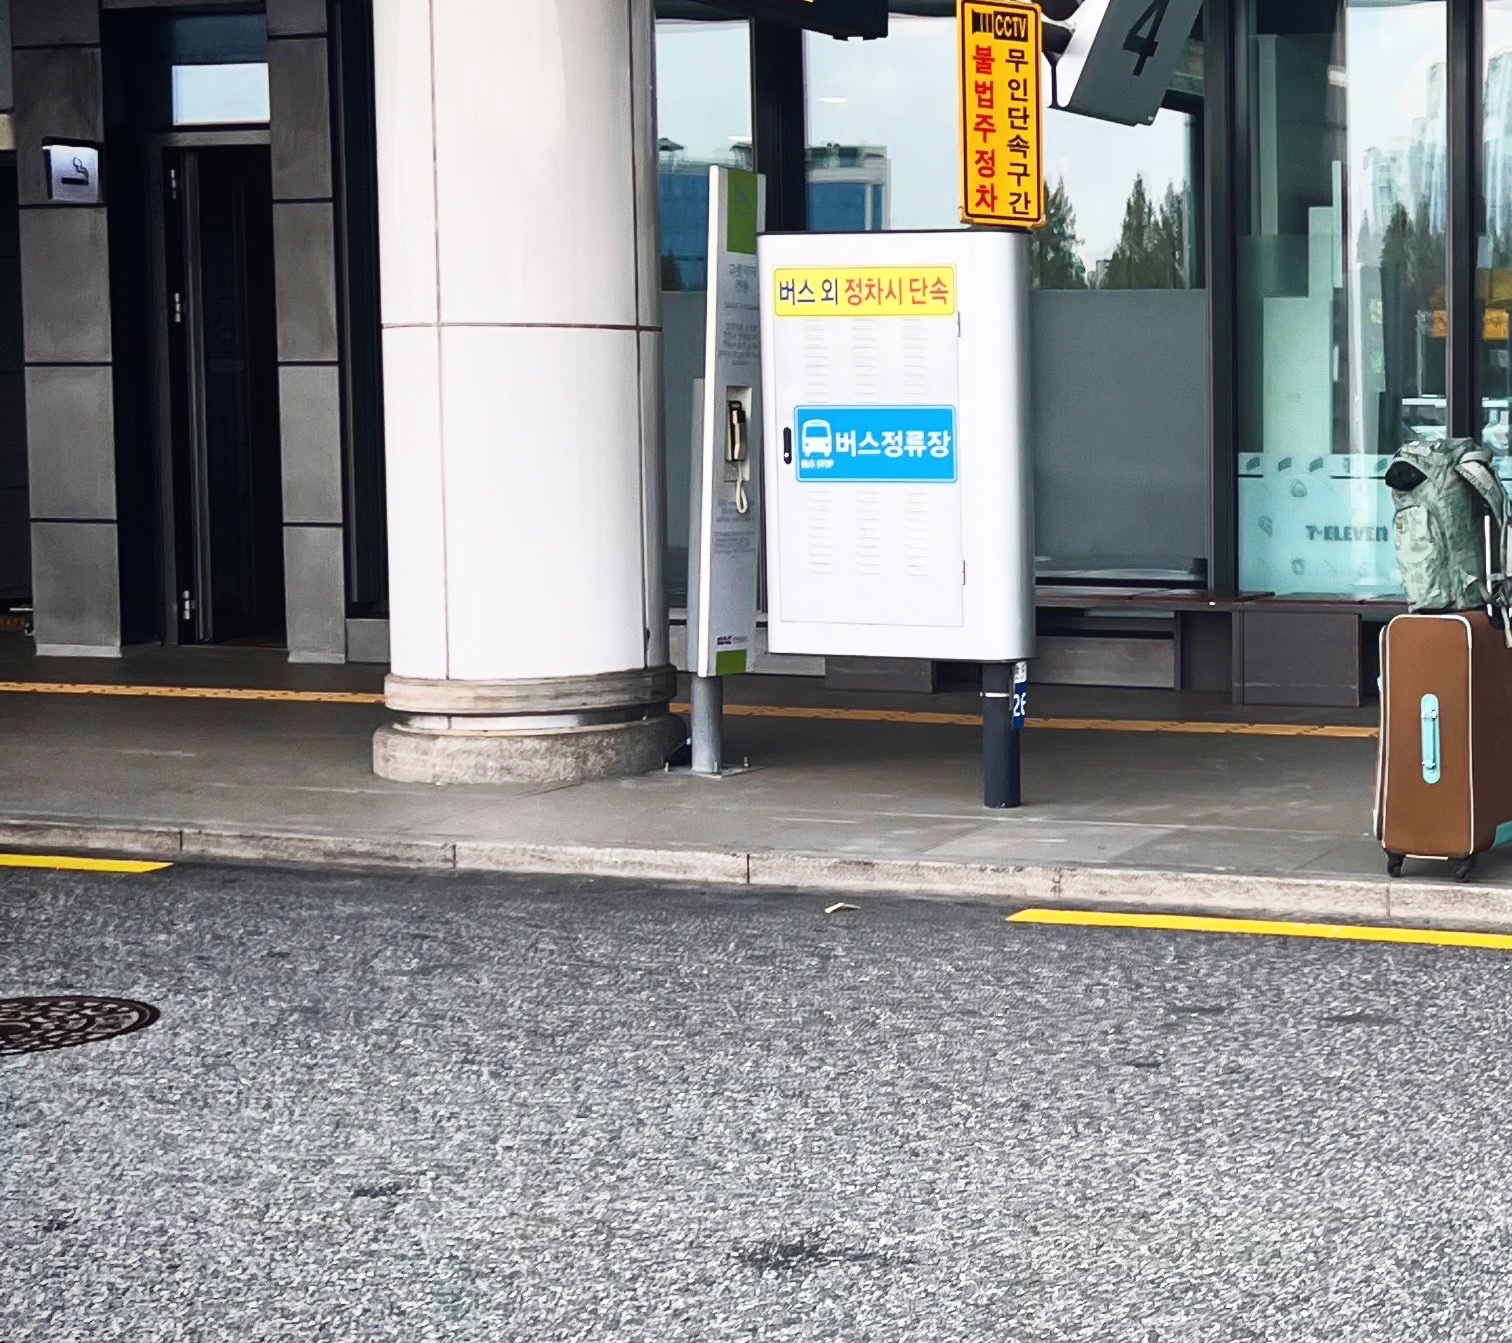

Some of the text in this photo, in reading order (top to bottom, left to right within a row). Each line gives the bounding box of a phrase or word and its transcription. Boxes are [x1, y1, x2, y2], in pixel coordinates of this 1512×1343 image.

[995, 13, 1028, 40] CCTV
[971, 43, 998, 213] 불법주정차
[1004, 48, 1032, 216] 무인단속구간
[779, 277, 949, 306] 버스 외 정차시 단속
[835, 430, 951, 458] 버스정류장
